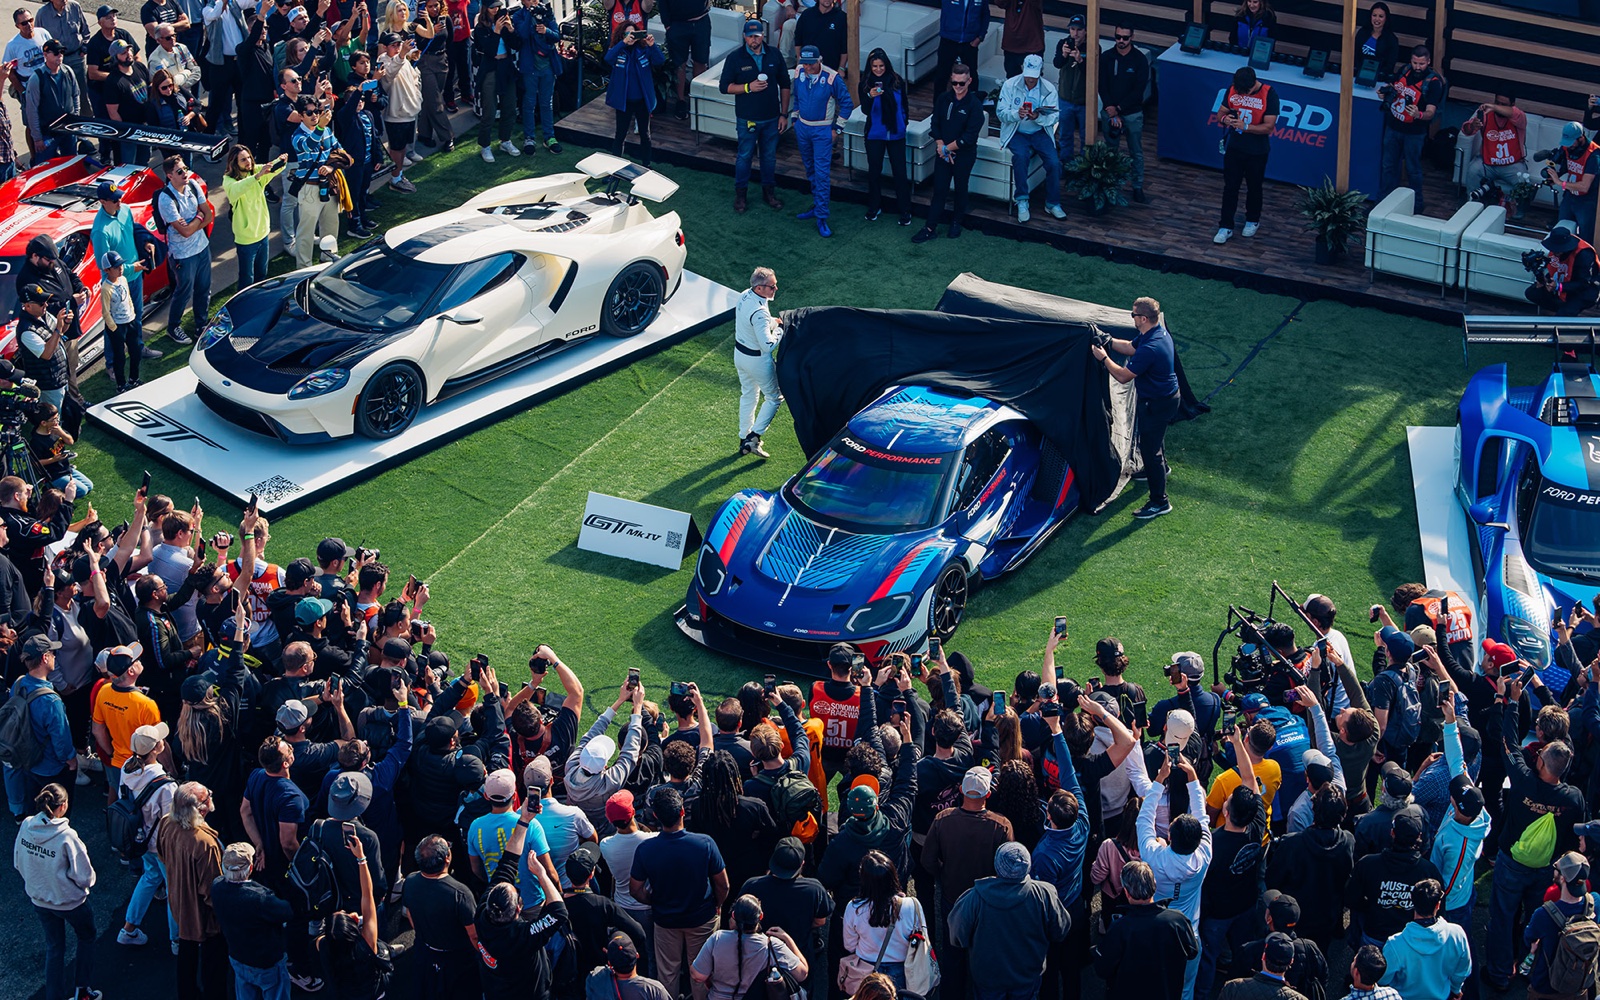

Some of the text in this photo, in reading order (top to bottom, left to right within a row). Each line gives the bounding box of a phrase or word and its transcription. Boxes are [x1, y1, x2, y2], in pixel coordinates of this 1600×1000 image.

[134, 129, 183, 142] Powered by
[1495, 142, 1510, 158] 31
[1490, 156, 1515, 165] PHOTO
[565, 324, 597, 339] FORD
[104, 401, 230, 452] GT
[1542, 486, 1577, 502] FORD
[583, 513, 643, 534] GT
[645, 532, 662, 541] IV
[1448, 609, 1467, 631] 25
[830, 702, 859, 711] SONOMA
[827, 719, 847, 738] 51
[1276, 734, 1305, 746] EcoBoost
[21, 838, 56, 858] ESSENTIALS
[1380, 881, 1409, 891] MUST
